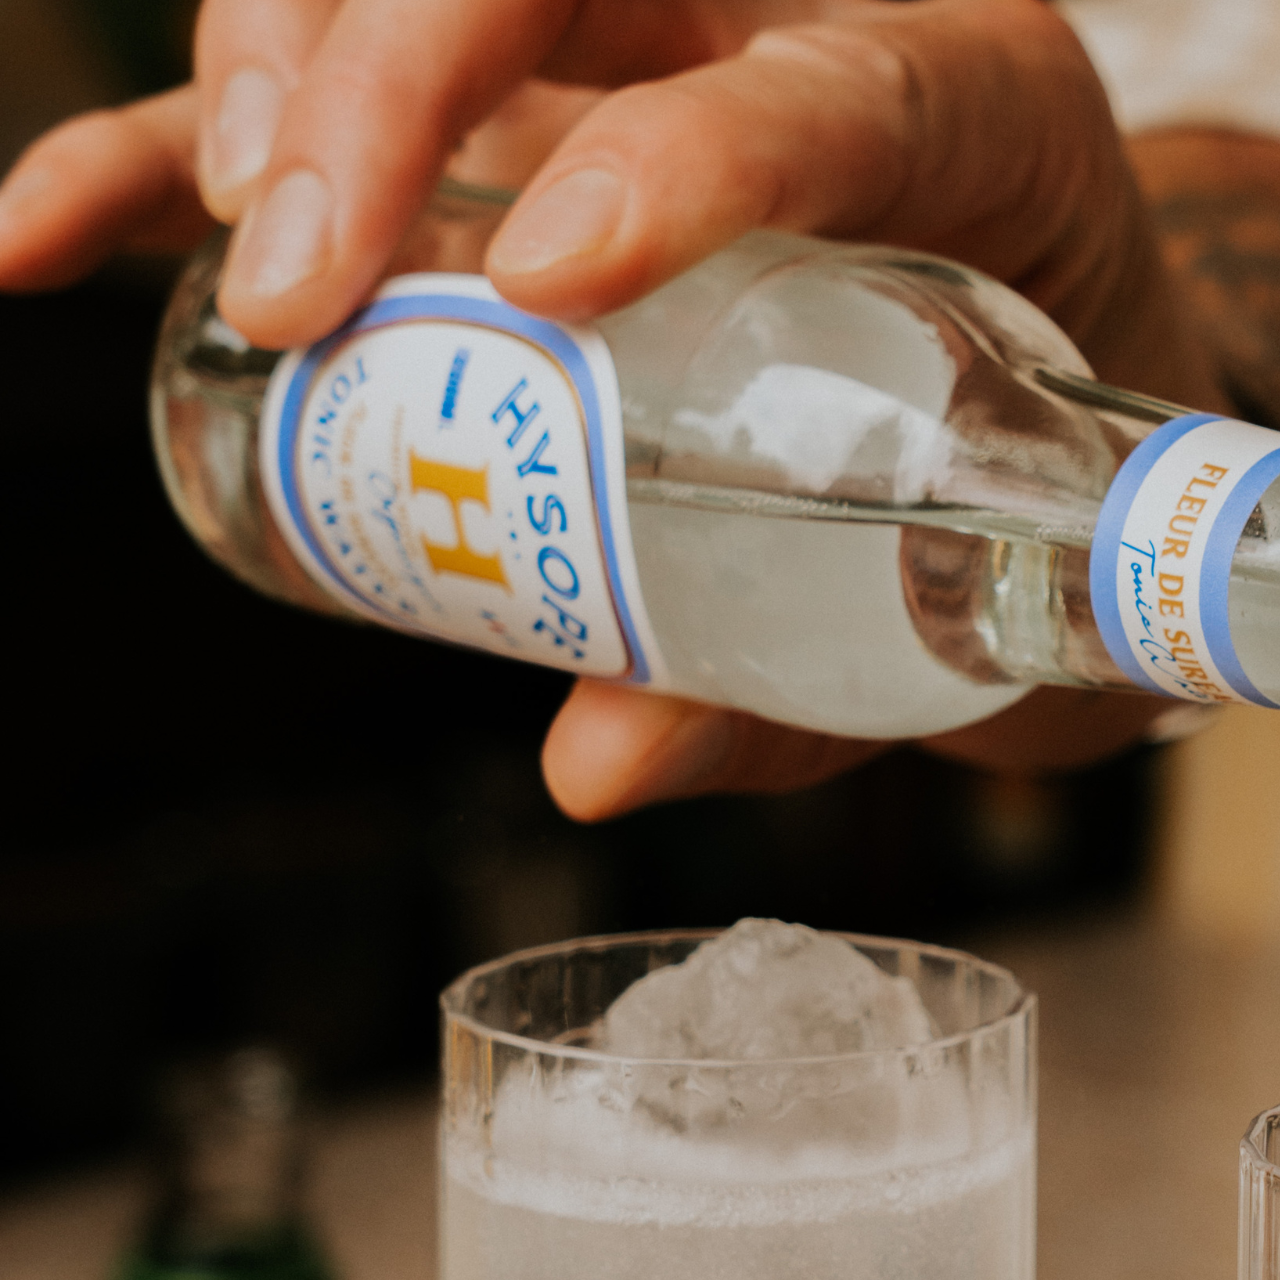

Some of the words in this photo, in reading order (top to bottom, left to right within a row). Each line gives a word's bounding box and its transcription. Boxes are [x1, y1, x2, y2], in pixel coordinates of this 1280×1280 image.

[409, 446, 515, 596] H
[491, 376, 589, 660] HYSOPE
[1160, 462, 1230, 560] FLEUR
[1120, 539, 1156, 638] Tonic
[1158, 571, 1185, 619] DE
